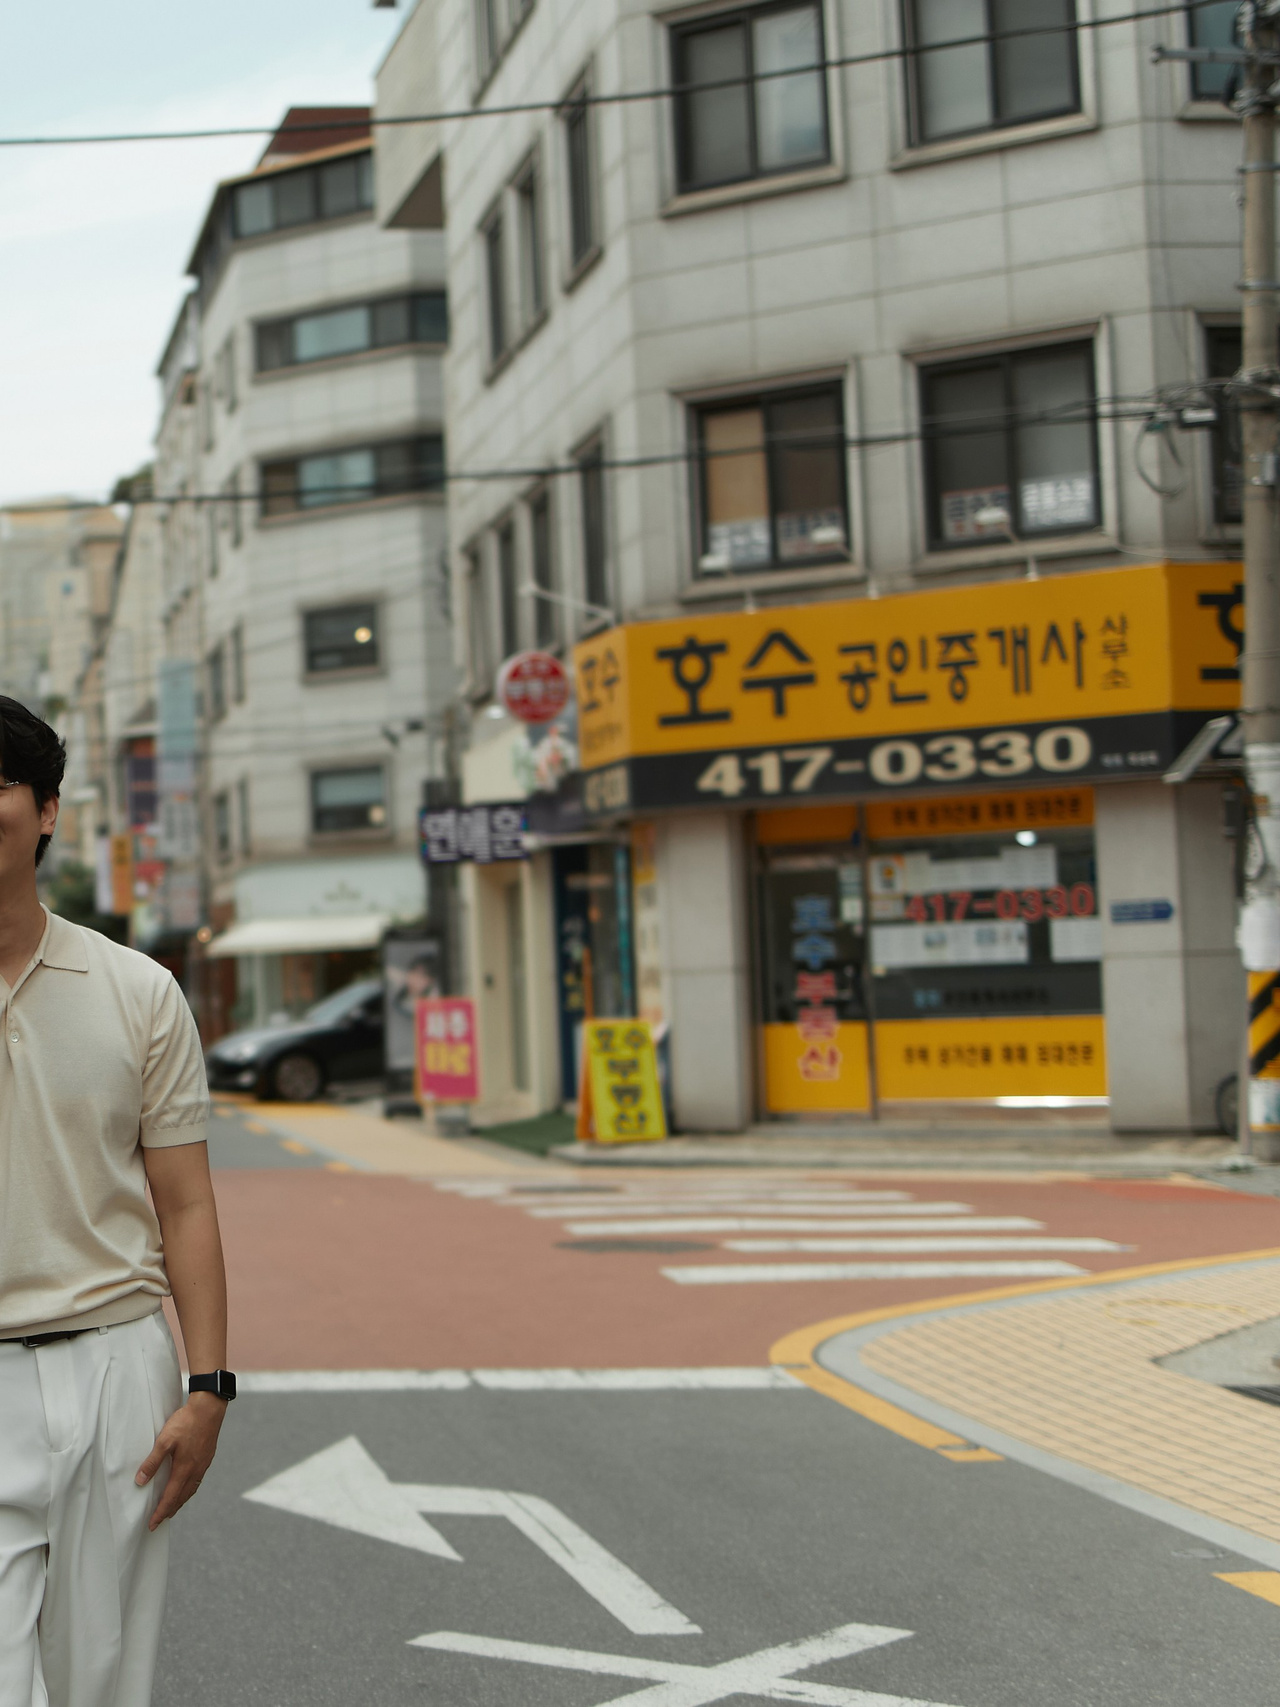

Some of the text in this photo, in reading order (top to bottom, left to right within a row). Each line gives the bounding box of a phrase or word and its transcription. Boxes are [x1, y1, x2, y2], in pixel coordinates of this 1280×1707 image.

[654, 617, 1087, 728] 호수 공인중개사
[695, 725, 1092, 797] 417-0330
[904, 881, 1095, 924] 417-0330
